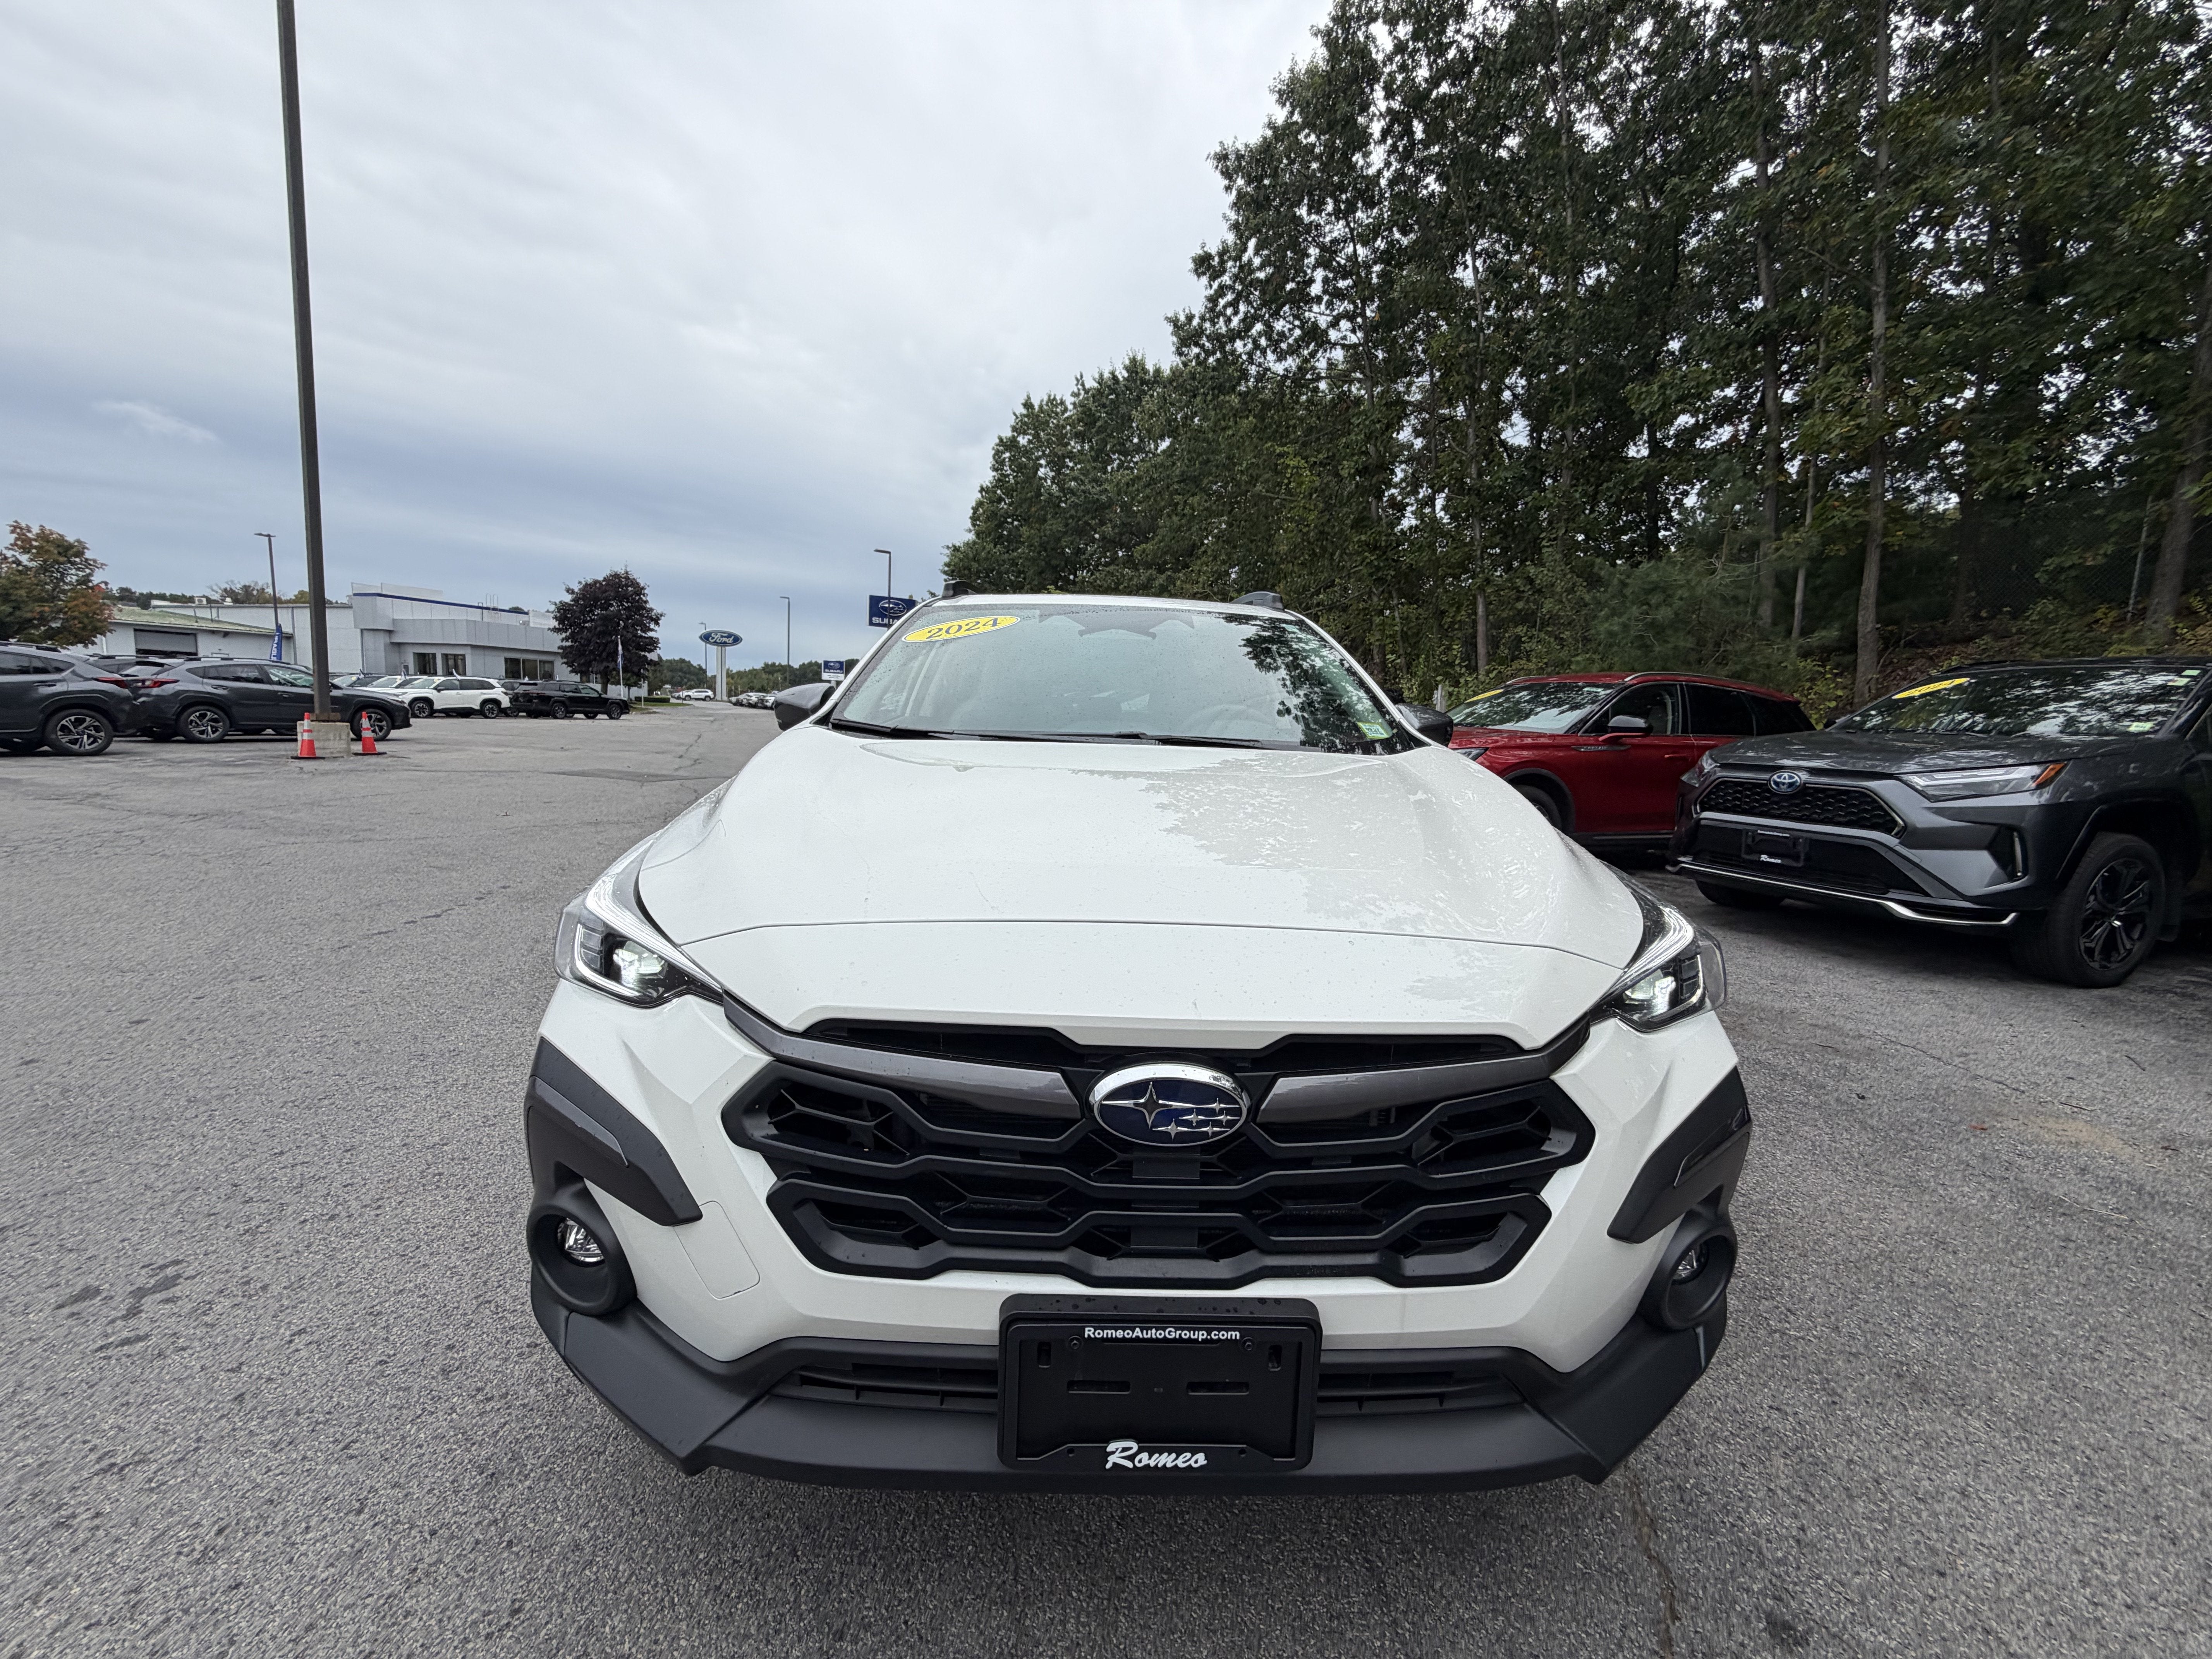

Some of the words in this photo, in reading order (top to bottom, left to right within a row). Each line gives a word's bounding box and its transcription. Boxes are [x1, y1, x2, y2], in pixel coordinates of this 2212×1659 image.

[926, 618, 1000, 639] 2024
[709, 632, 733, 643] Ford
[1760, 855, 1781, 863] Romeo
[1085, 1327, 1240, 1341] RomeoAutoGroup.com
[1105, 1441, 1207, 1469] Romeo
